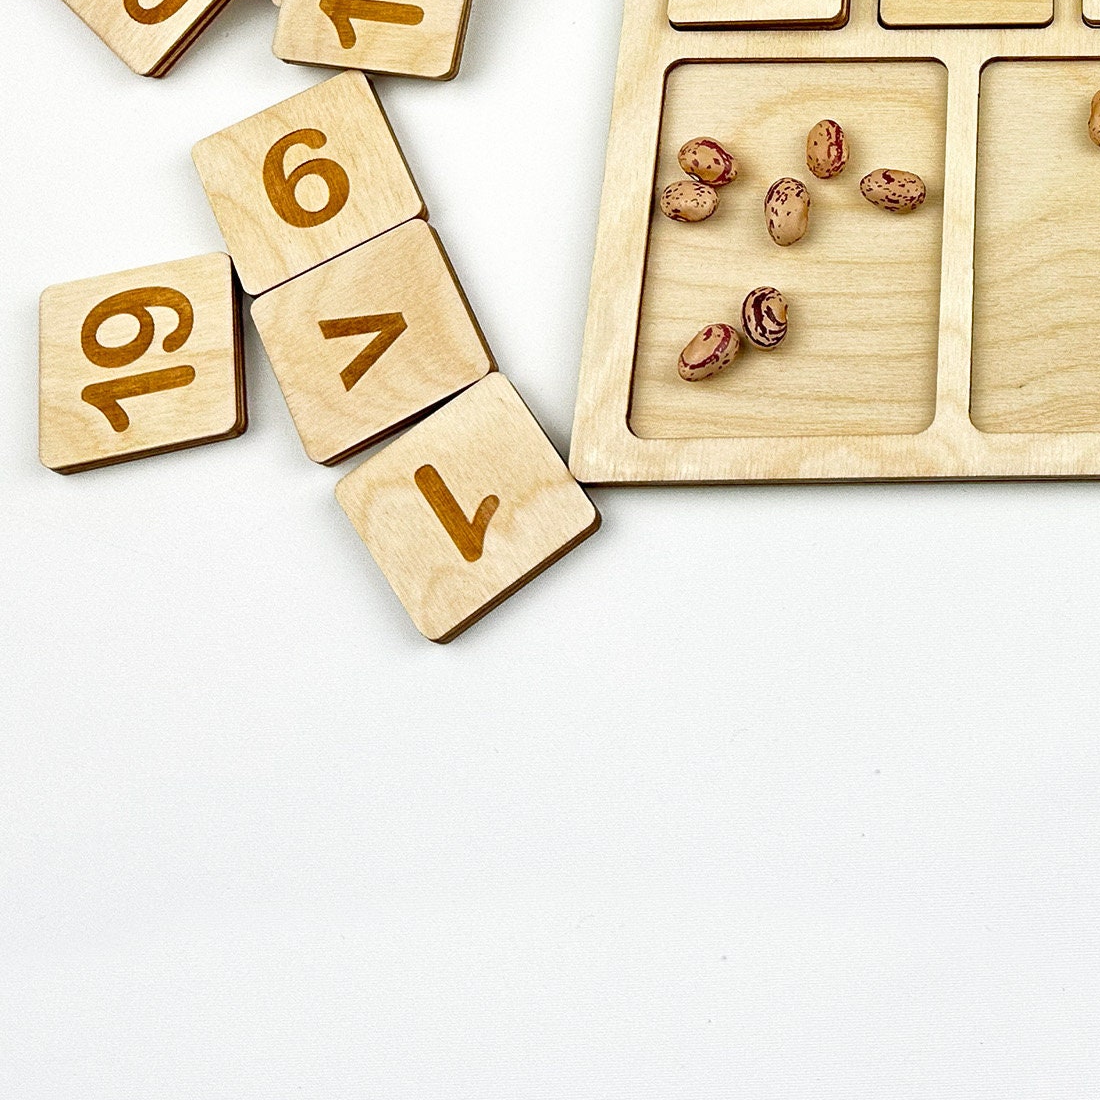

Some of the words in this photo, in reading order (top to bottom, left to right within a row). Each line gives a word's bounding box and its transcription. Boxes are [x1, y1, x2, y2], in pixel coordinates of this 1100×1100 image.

[263, 128, 350, 228] 6
[81, 286, 196, 432] 19
[414, 464, 500, 563] 1
